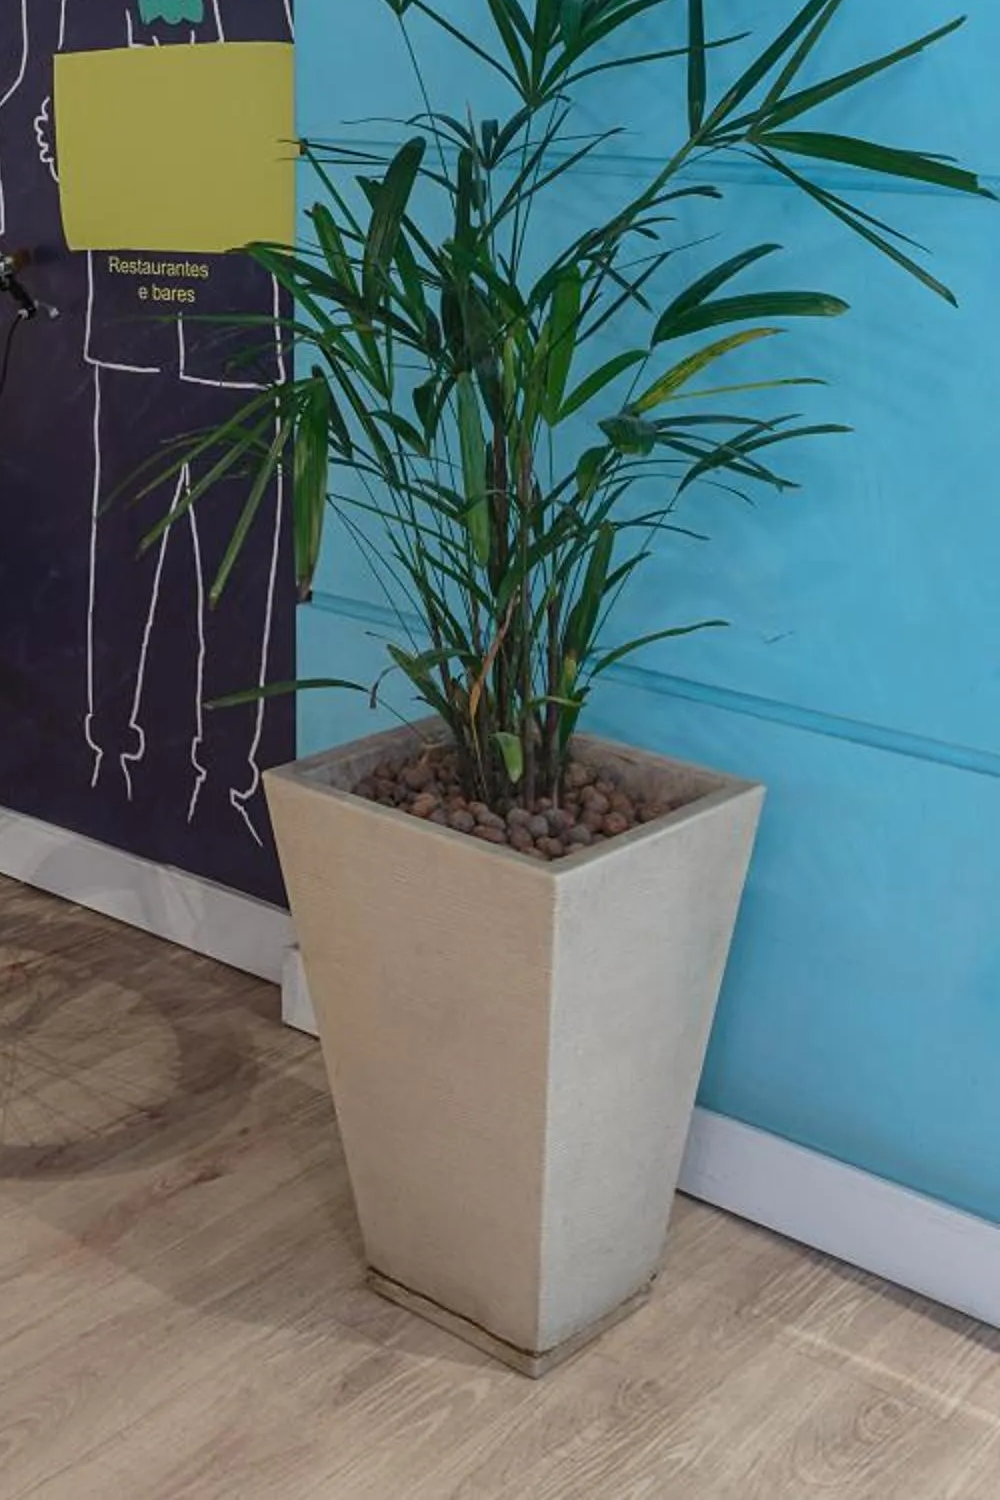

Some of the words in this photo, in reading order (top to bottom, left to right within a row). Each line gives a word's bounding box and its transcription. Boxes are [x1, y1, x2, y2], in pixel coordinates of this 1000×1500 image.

[107, 255, 210, 278] Restaurantes
[137, 285, 149, 300] e
[151, 283, 197, 303] bares
